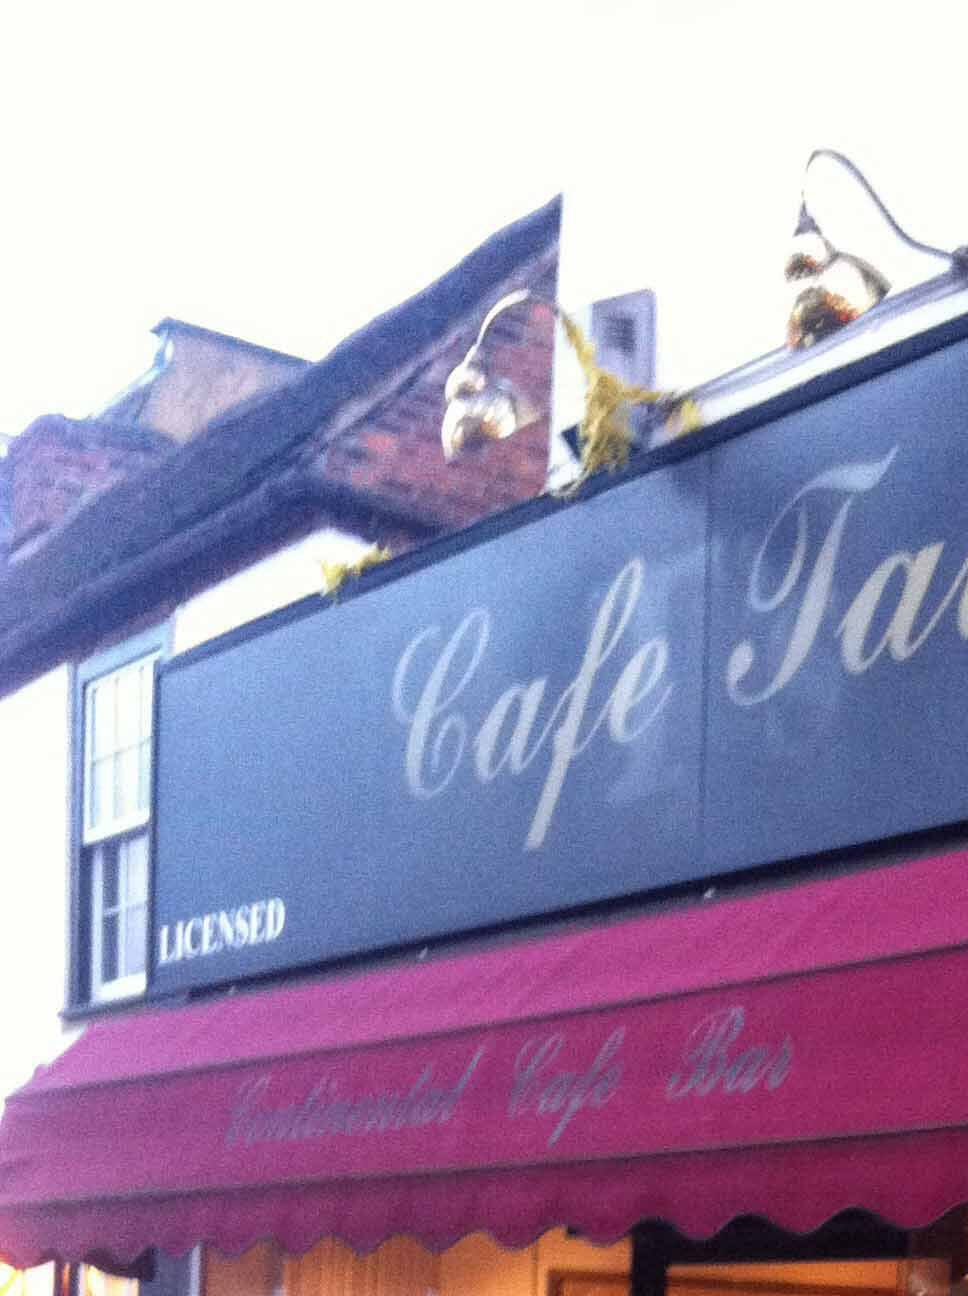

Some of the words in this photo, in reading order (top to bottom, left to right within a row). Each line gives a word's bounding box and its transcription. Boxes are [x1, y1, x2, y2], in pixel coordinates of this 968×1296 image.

[392, 556, 673, 853] Cafe
[159, 896, 287, 965] LICENSED
[666, 1005, 794, 1101] Bar
